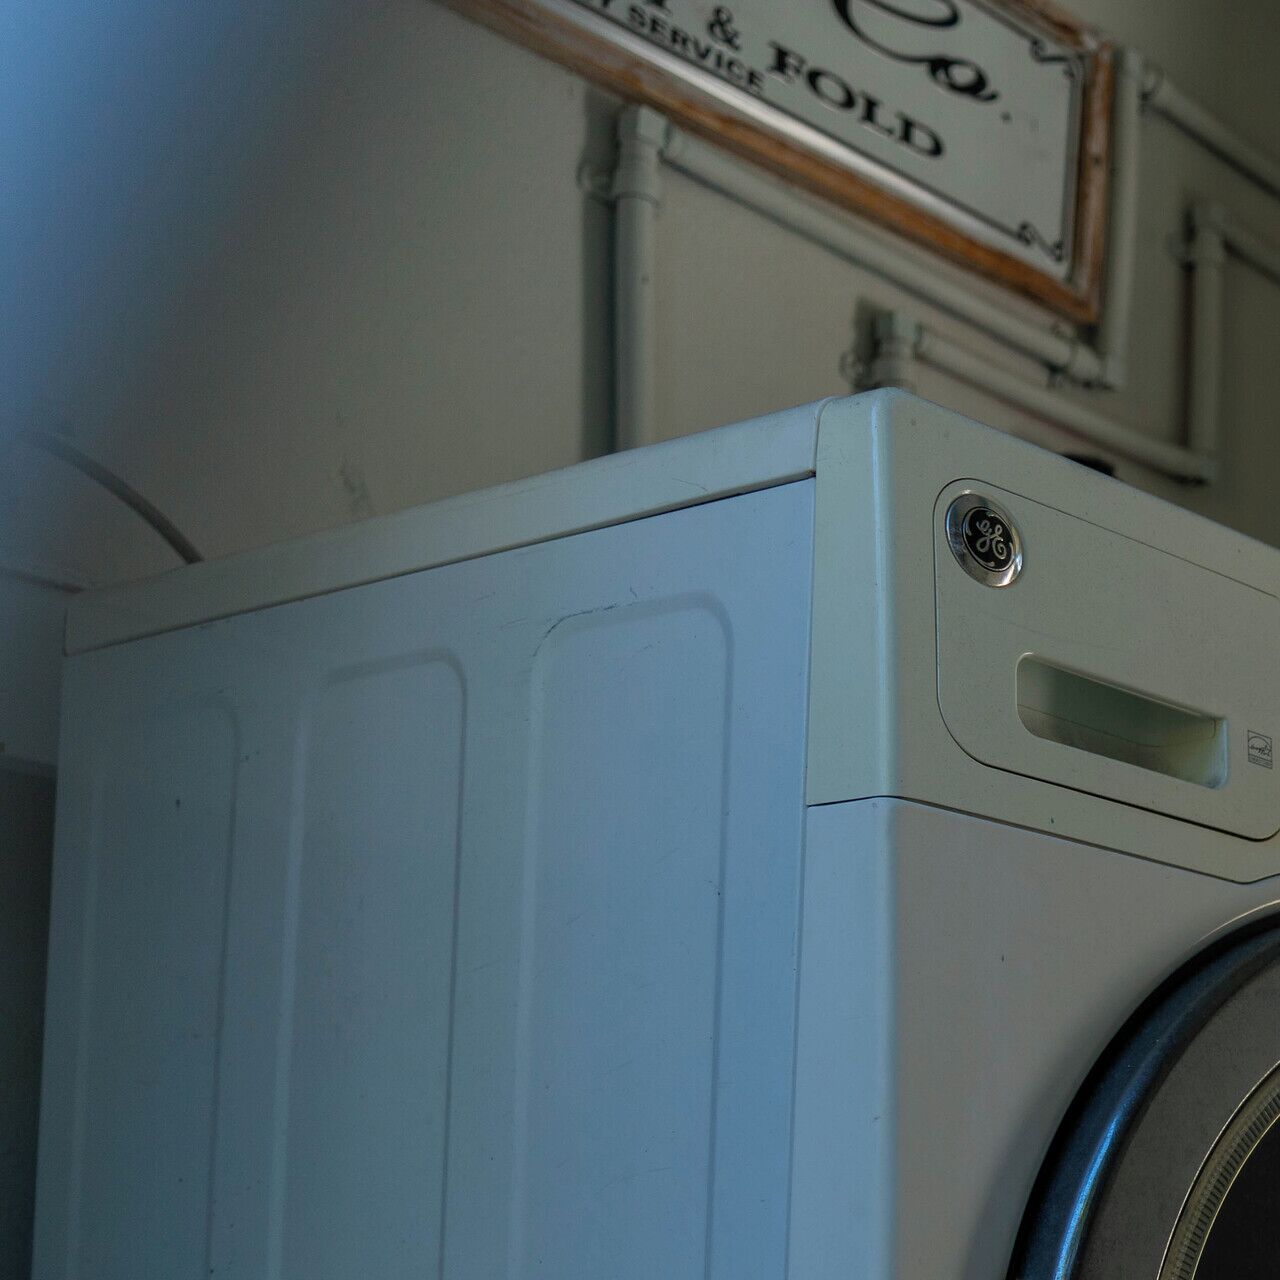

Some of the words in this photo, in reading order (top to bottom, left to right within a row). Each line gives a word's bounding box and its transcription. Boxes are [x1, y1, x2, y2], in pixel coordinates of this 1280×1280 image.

[629, 5, 765, 96] SERVICE
[707, 5, 742, 51] &
[768, 40, 945, 158] FOLD
